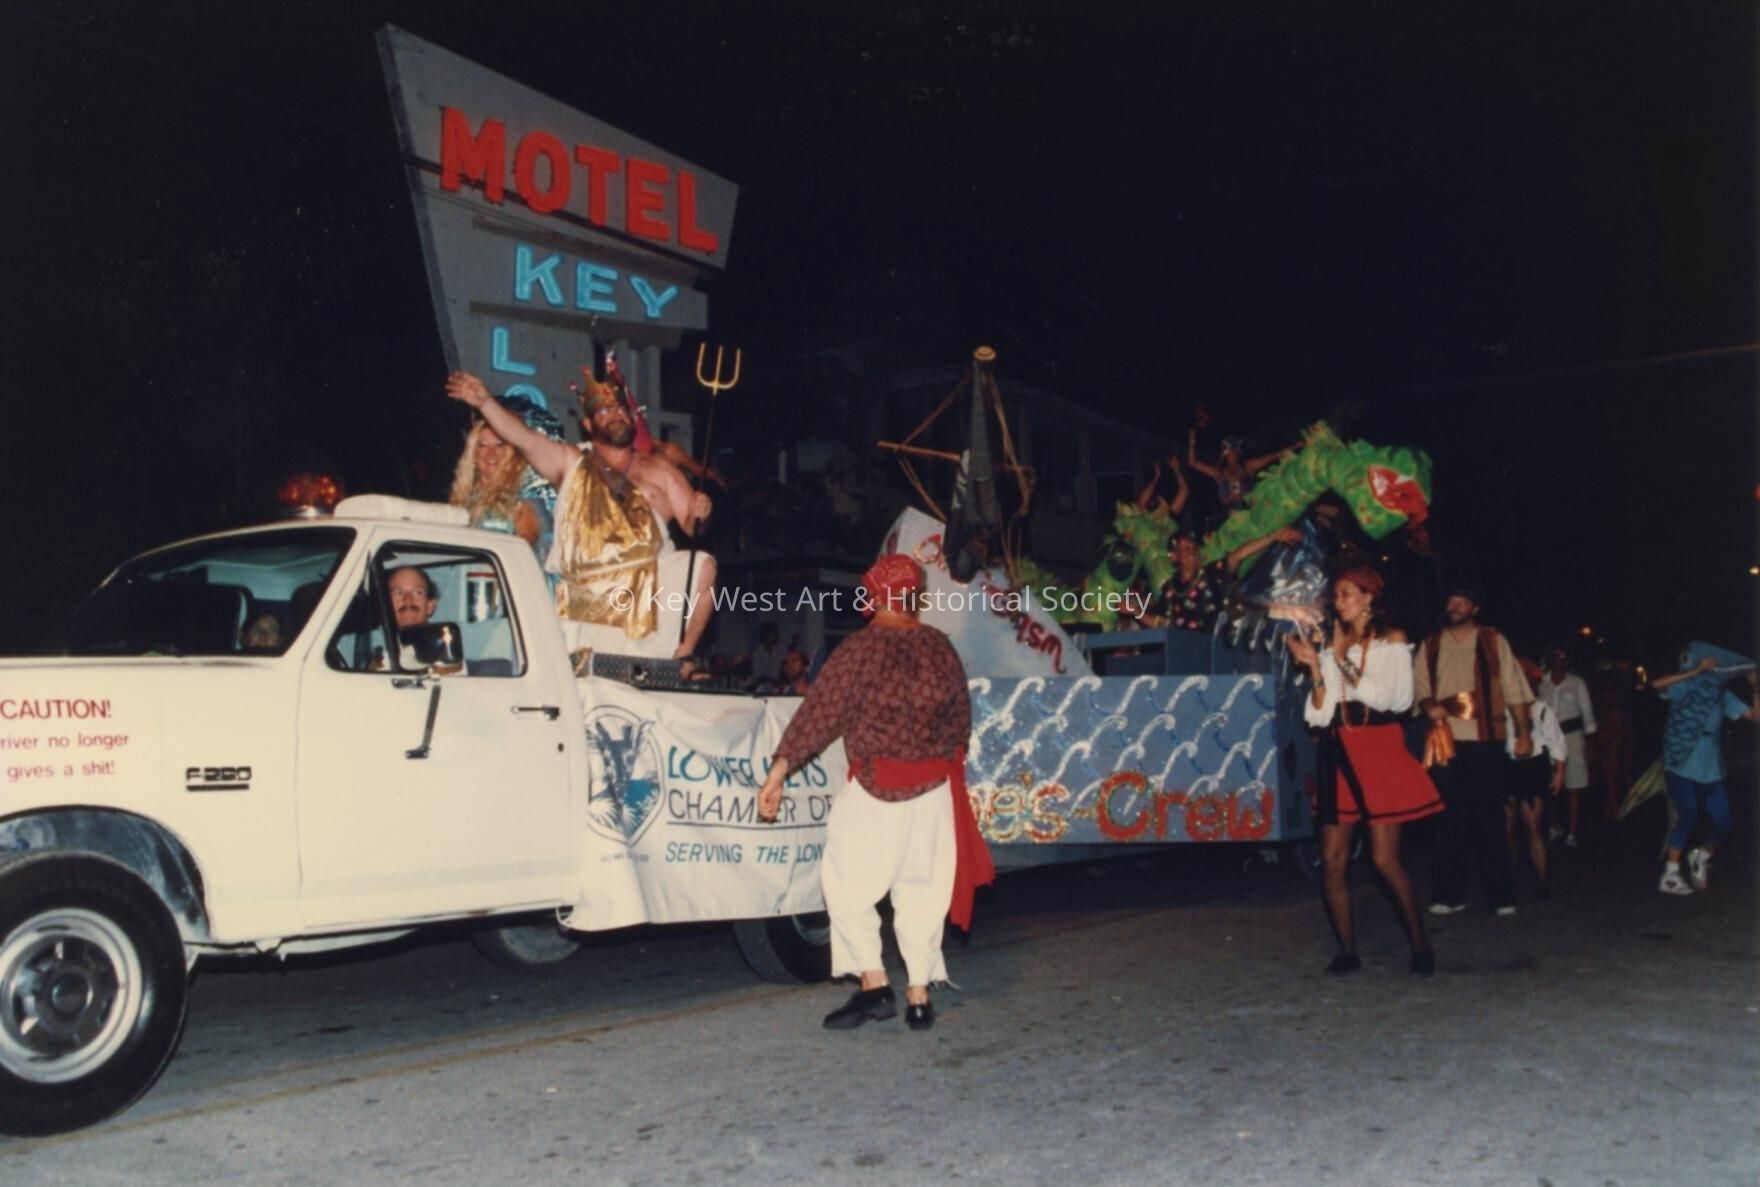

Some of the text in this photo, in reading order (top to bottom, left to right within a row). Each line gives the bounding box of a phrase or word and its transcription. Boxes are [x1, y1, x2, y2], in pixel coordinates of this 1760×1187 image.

[440, 106, 717, 253] MOTEL
[515, 246, 678, 318] KEY
[0, 699, 112, 719] CAUTION!
[49, 736, 70, 748] no
[78, 732, 129, 751] longer
[7, 760, 115, 783] gives a shit!
[1096, 772, 1274, 841] Crew
[665, 841, 743, 864] SERVING
[756, 845, 789, 864] THE
